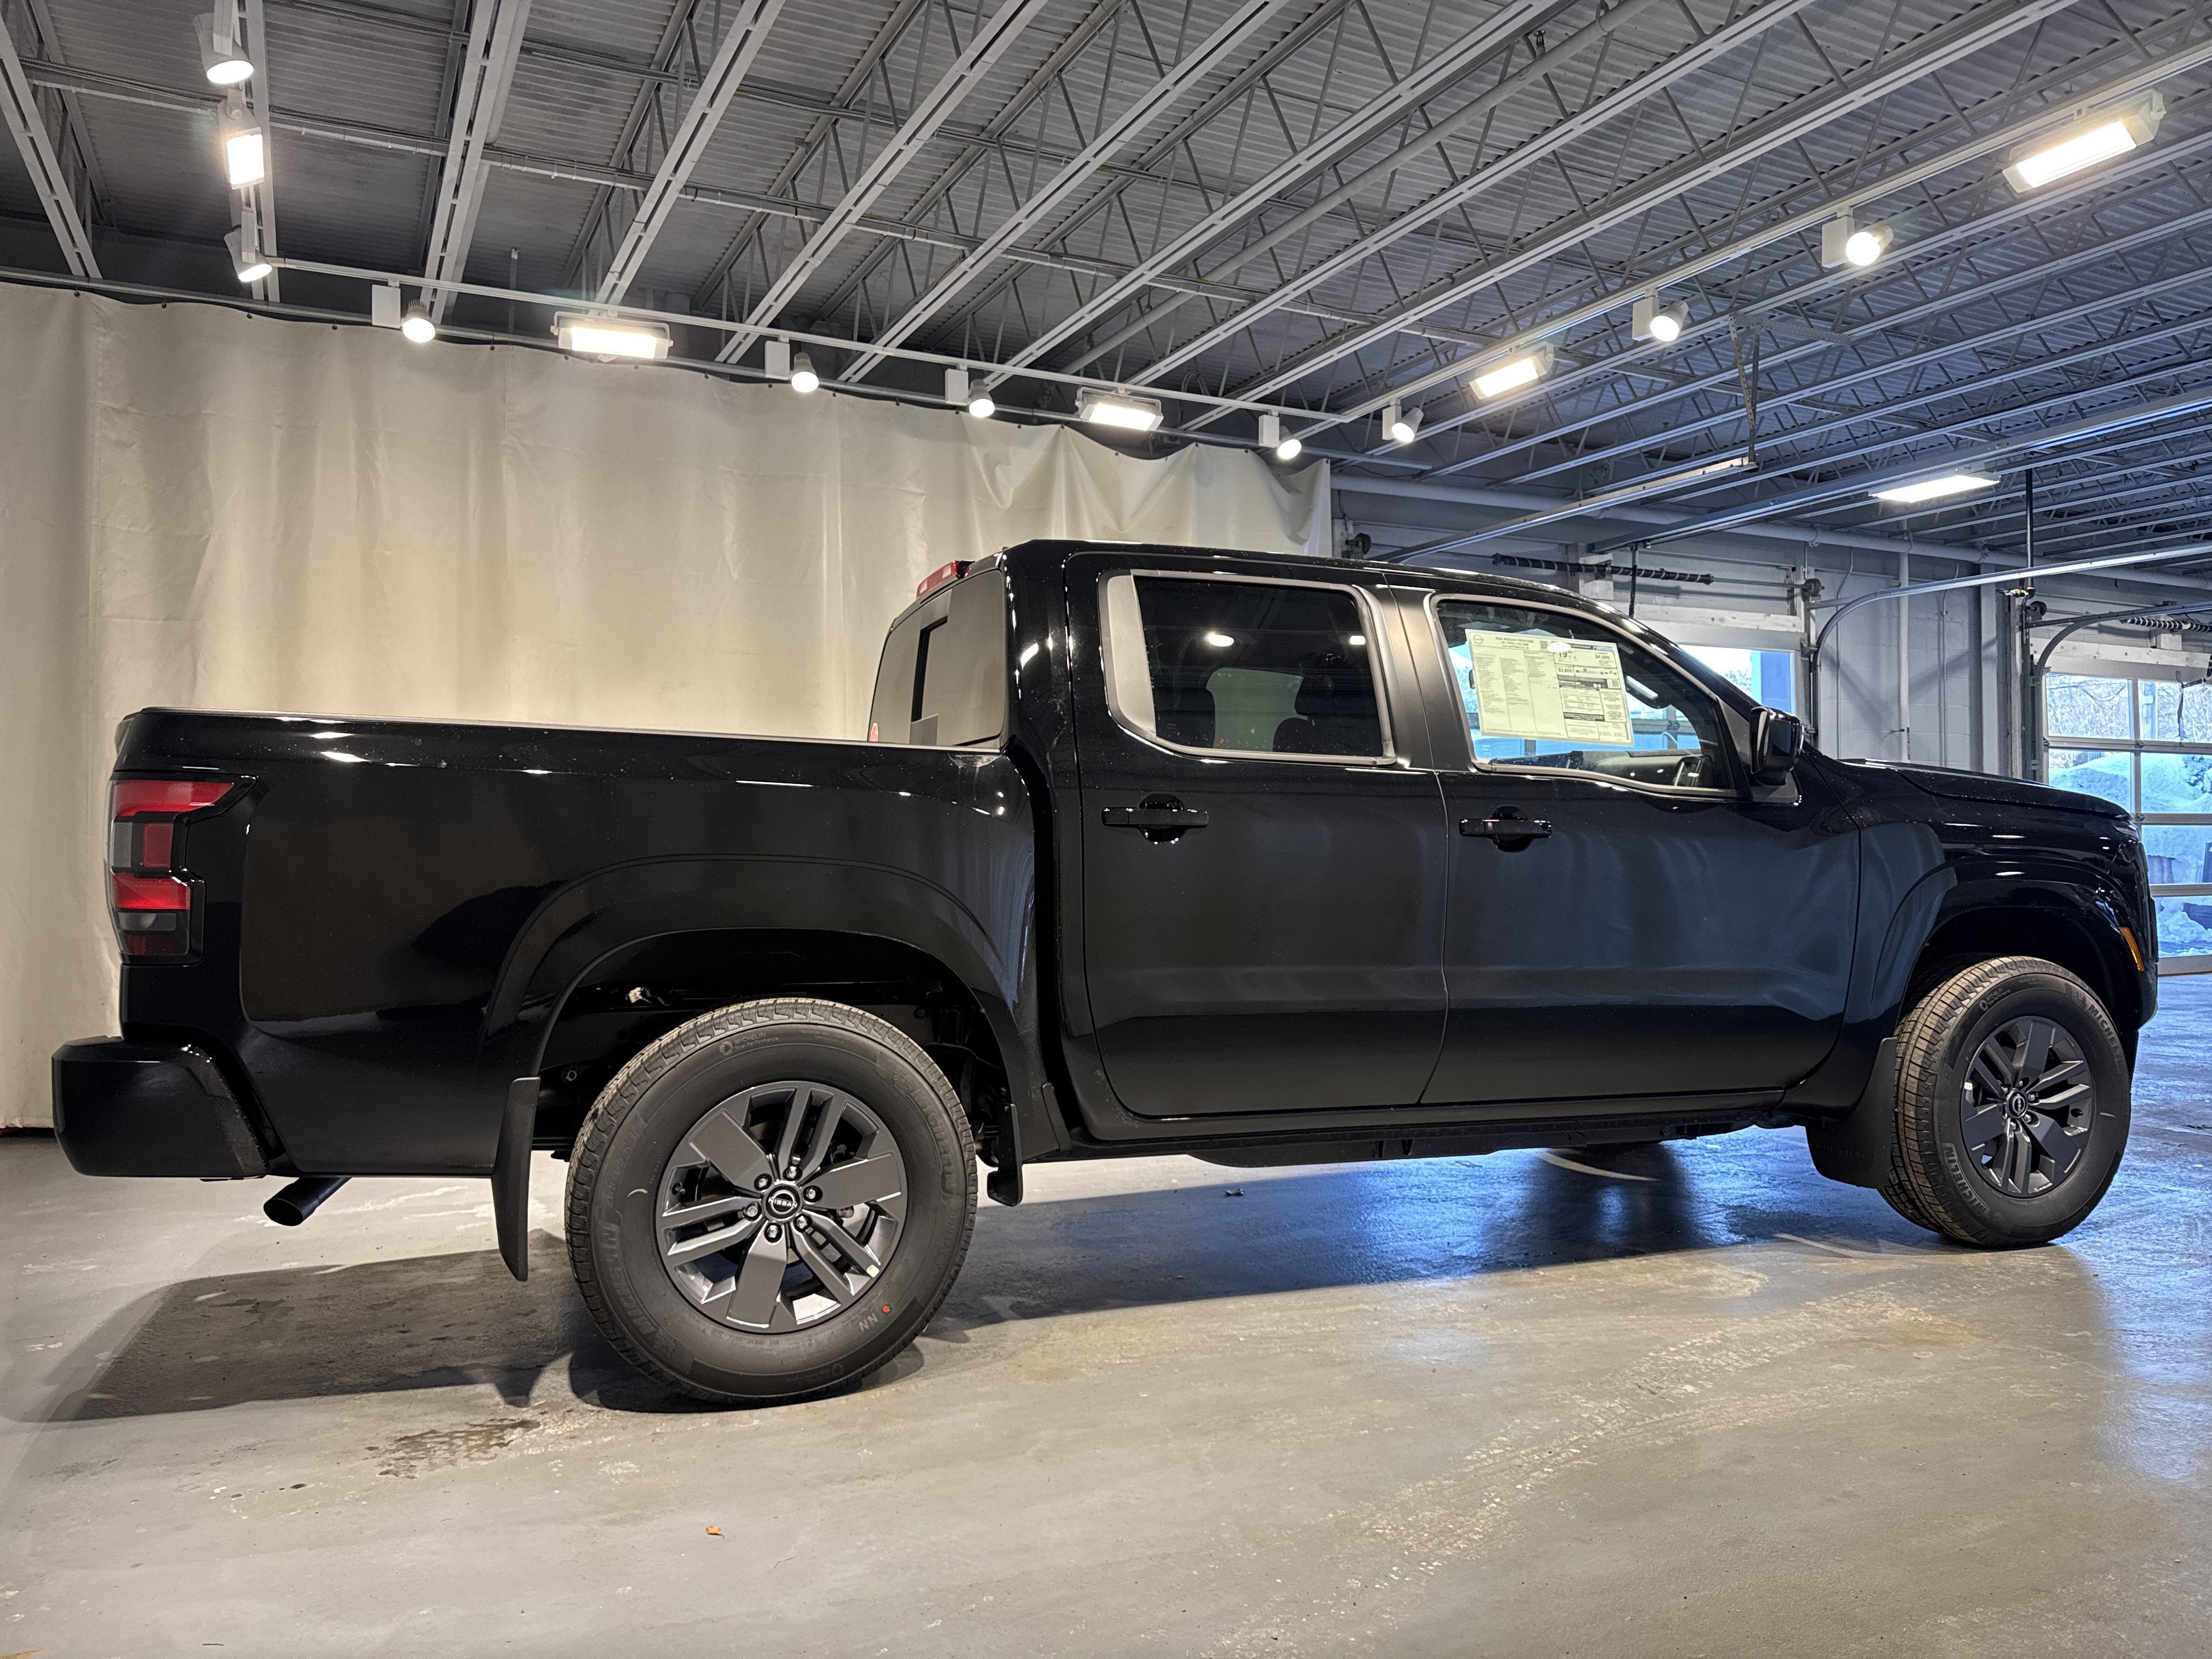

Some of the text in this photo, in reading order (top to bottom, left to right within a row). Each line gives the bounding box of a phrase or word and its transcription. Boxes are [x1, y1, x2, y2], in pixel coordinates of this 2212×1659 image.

[733, 1031, 767, 1045] MICHELIN
[747, 1037, 780, 1049] Performance
[2088, 1004, 2125, 1070] MICHELIN
[910, 1089, 957, 1191] MICHELIN
[768, 1198, 798, 1208] NISSAN
[1944, 1147, 1988, 1214] MICHELIN
[602, 1227, 656, 1335] MICHELIN
